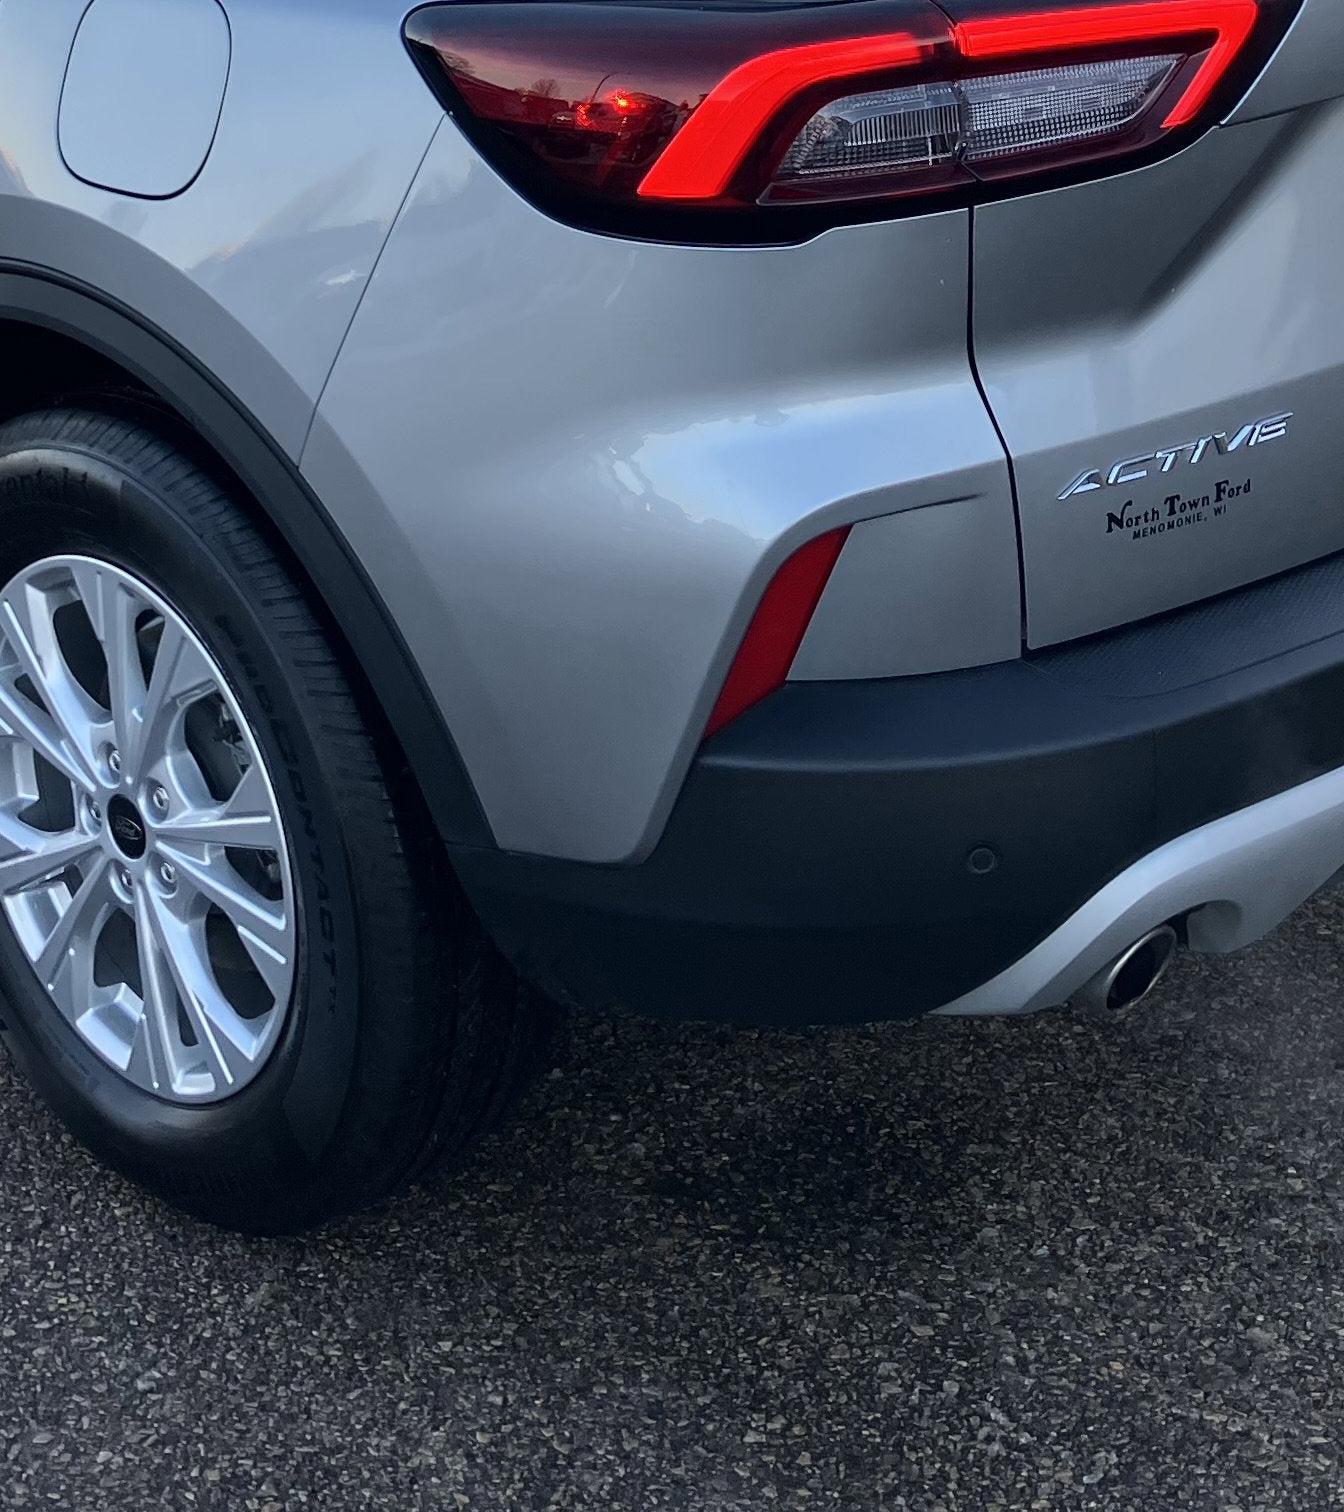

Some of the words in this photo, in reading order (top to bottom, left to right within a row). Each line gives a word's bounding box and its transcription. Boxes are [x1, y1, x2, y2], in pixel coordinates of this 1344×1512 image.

[1057, 411, 1294, 501] ACTIVE
[1105, 500, 1160, 534] North
[1164, 494, 1210, 517] Town
[1214, 478, 1252, 503] Ford
[1213, 504, 1228, 518] WI
